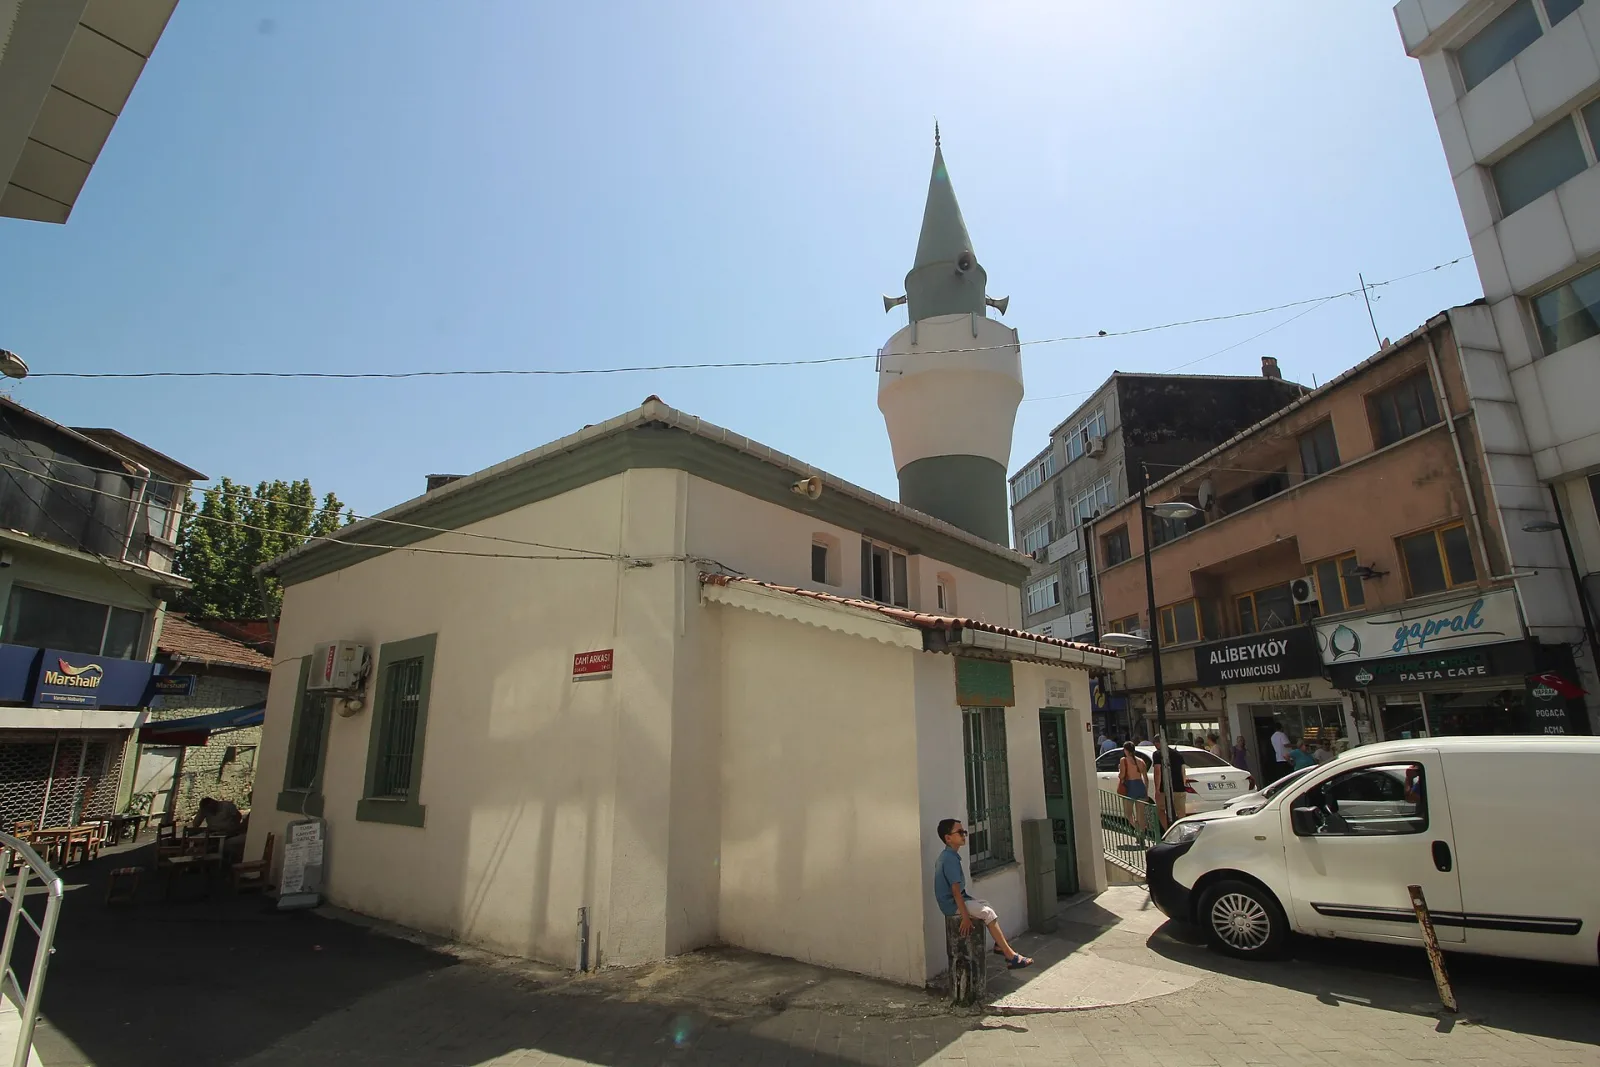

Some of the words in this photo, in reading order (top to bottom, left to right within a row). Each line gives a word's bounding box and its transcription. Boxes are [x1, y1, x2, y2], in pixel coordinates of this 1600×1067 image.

[1391, 598, 1485, 652] yaprak
[589, 653, 610, 664] ARKASI
[1209, 638, 1288, 665] ALİBEYKÖY
[44, 670, 97, 688] Marshall
[1220, 663, 1281, 680] KUYUMCUSU
[1400, 671, 1443, 682] PASTA
[1447, 665, 1486, 678] CAFE
[1258, 683, 1312, 701] YILMAZ
